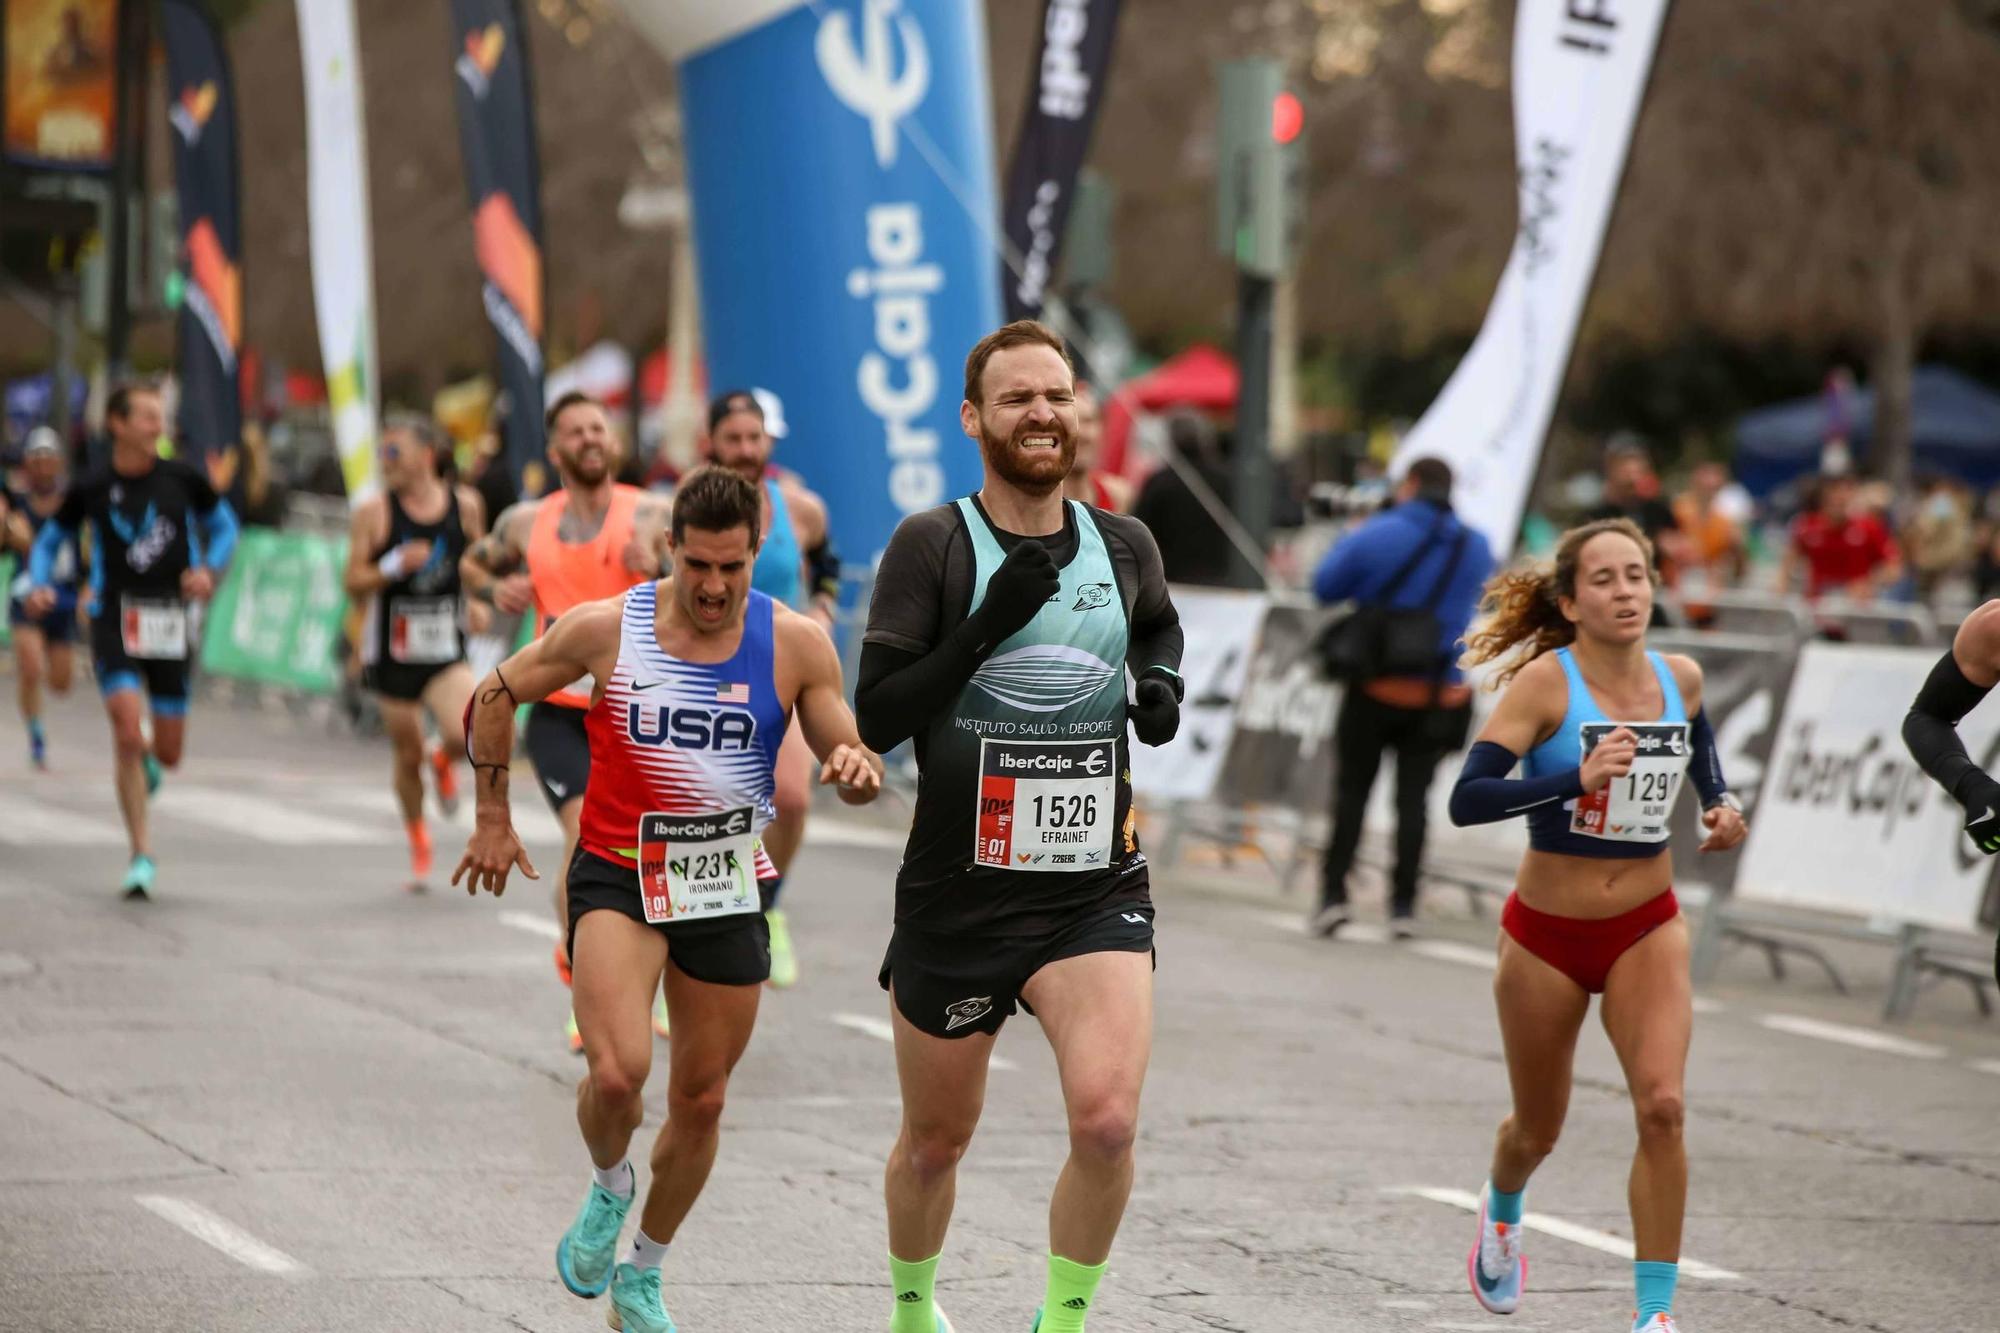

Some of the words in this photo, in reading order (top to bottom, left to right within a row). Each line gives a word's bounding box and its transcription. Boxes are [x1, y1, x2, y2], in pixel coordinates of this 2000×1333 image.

[847, 202, 944, 514] erCaja
[629, 703, 755, 751] USA
[955, 717, 1015, 734] INSTITUTO
[1019, 723, 1058, 735] SALUD
[1069, 720, 1113, 734] DEPORTE
[1000, 753, 1072, 773] iberCaja
[1033, 795, 1097, 828] 1526
[654, 822, 717, 838] iberCaja
[1042, 831, 1089, 843] EFRAINET
[988, 838, 1006, 857] 01
[1052, 854, 1076, 864] 226ERS
[688, 880, 733, 894] IRONMANU
[653, 895, 667, 913] 01
